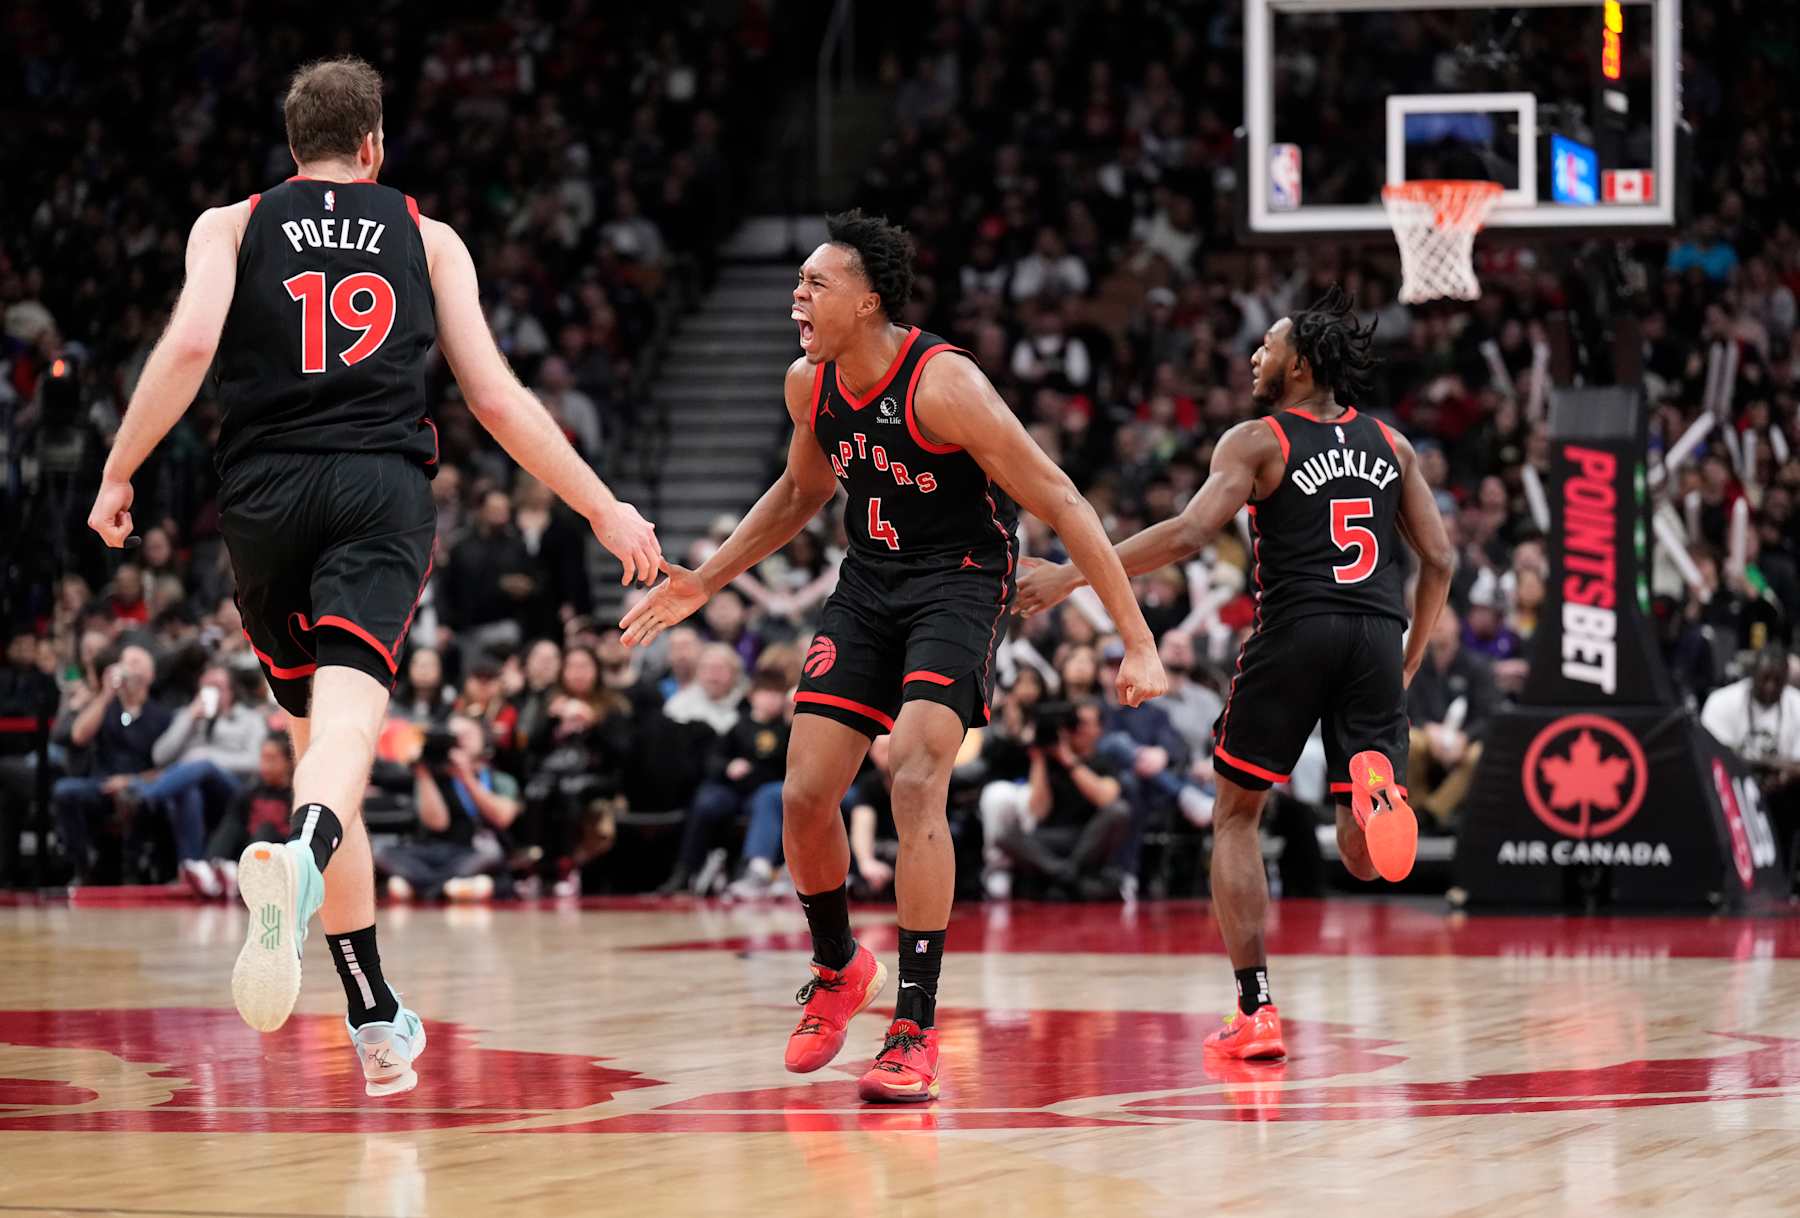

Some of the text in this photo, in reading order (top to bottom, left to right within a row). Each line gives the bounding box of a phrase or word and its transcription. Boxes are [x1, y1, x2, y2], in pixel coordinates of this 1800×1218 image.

[281, 218, 386, 255] POELTL
[283, 270, 396, 373] 19
[876, 416, 902, 424] Sun Life
[831, 432, 938, 493] APTORS
[1291, 448, 1399, 496] QUICKLEY
[867, 497, 900, 550] 4
[1329, 497, 1379, 584] 5
[1561, 444, 1617, 695] POINTSBET
[1497, 840, 1672, 867] AIR CANADA
